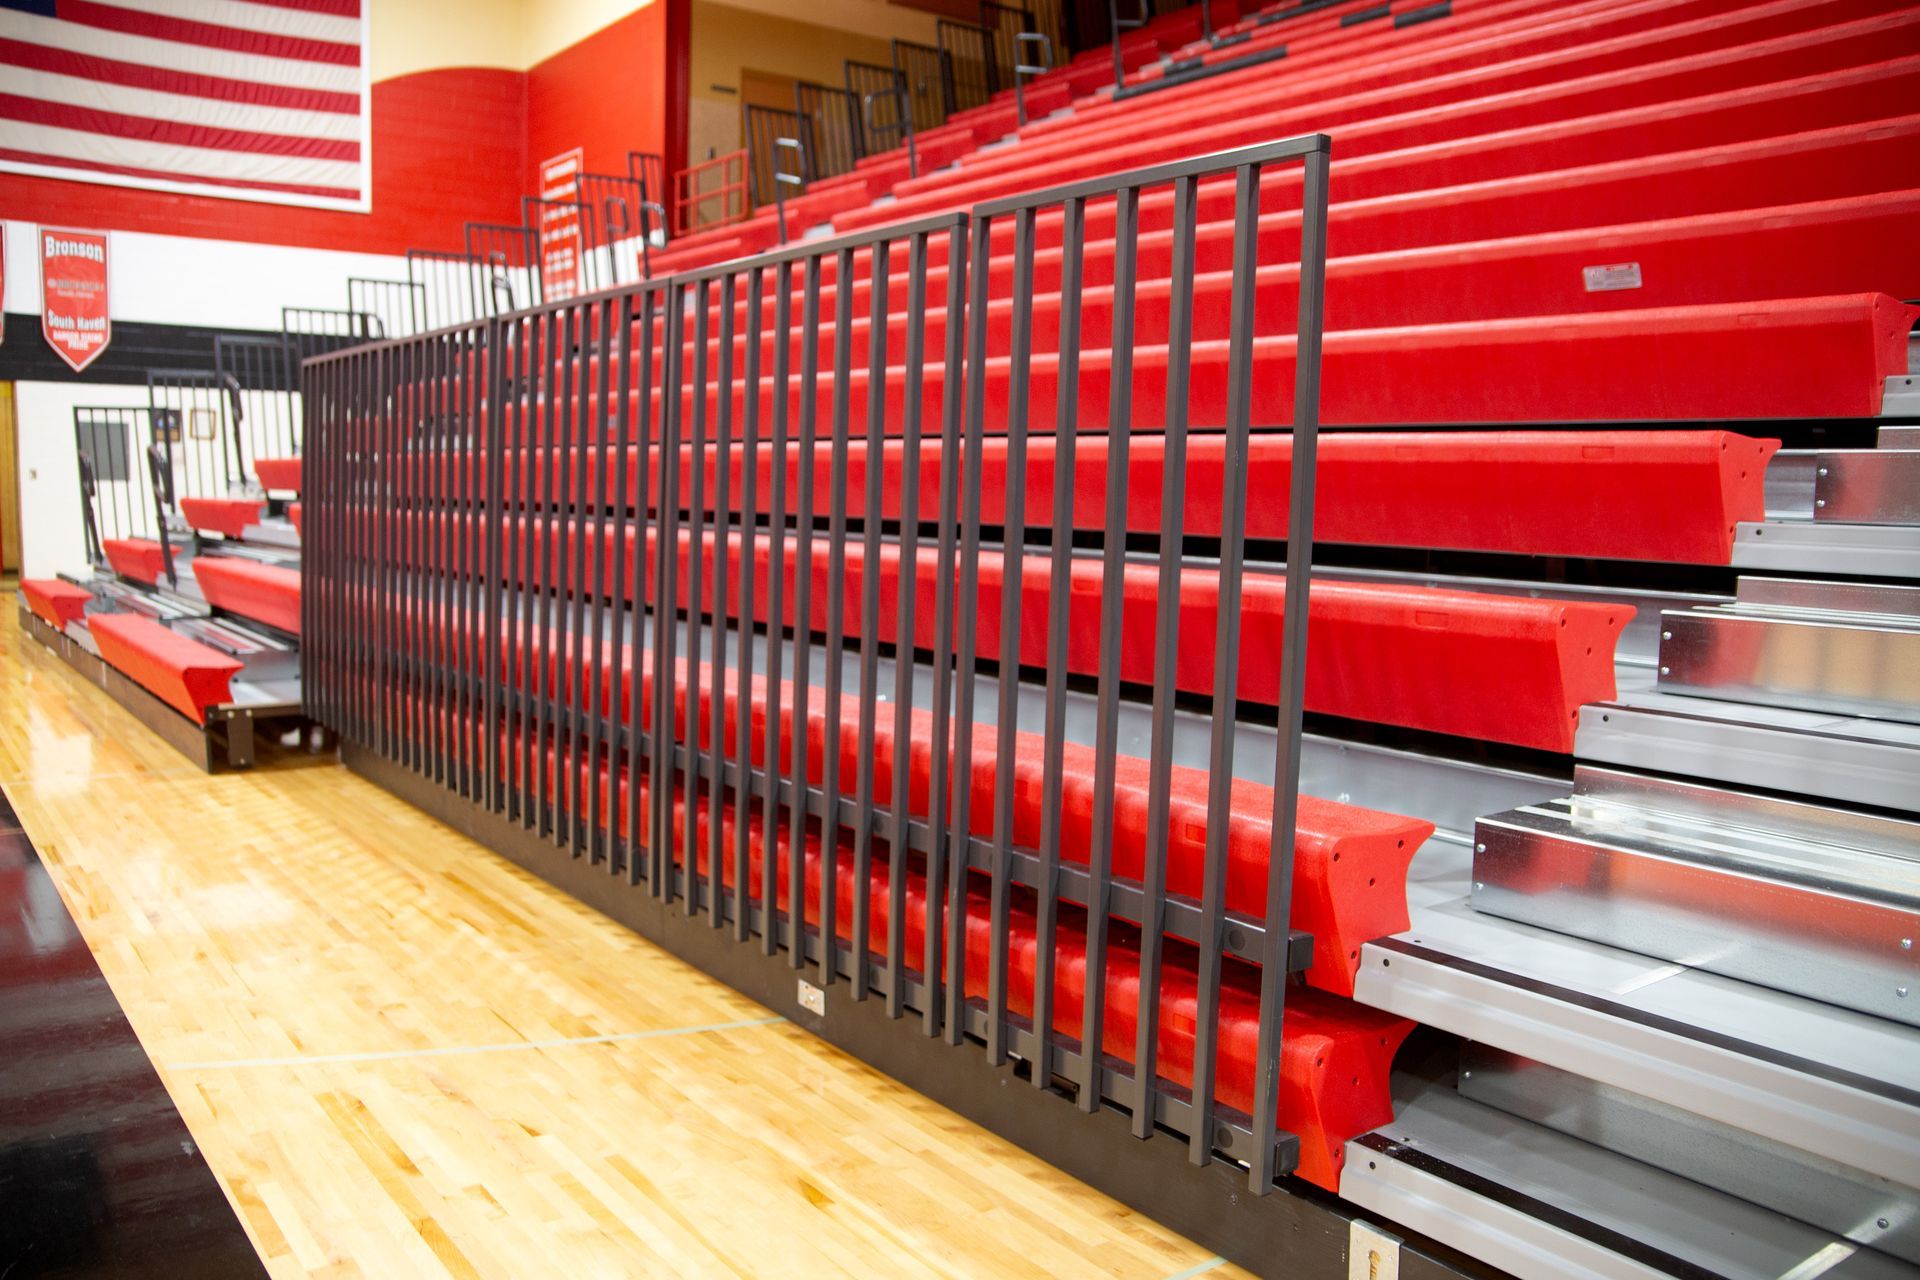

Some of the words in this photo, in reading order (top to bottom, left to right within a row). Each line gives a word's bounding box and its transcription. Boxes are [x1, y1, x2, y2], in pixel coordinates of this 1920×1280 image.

[45, 236, 103, 262] Bronson
[48, 309, 74, 327] South
[77, 317, 105, 330] Haven
